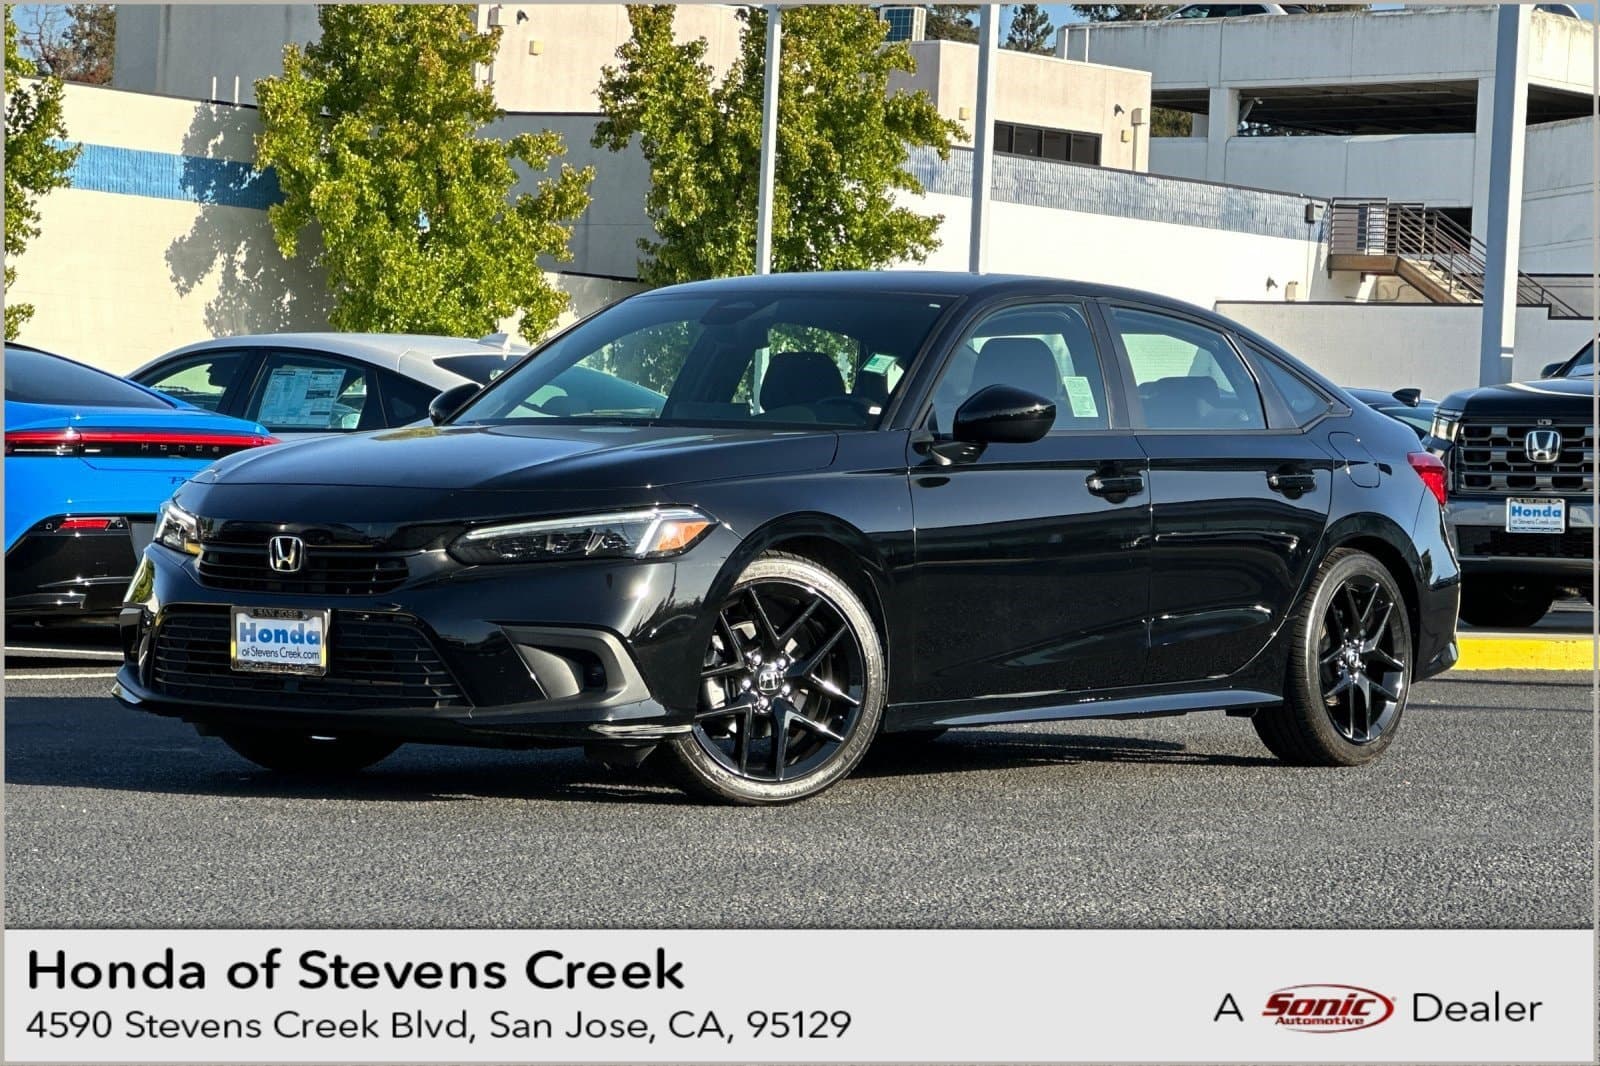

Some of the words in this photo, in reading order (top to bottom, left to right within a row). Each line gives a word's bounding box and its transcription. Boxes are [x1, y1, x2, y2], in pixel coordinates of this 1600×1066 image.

[1511, 506, 1562, 517] Honda
[240, 622, 321, 645] Honda
[241, 647, 251, 656] of
[250, 646, 279, 658] Stevens
[279, 646, 320, 660] Creek.com
